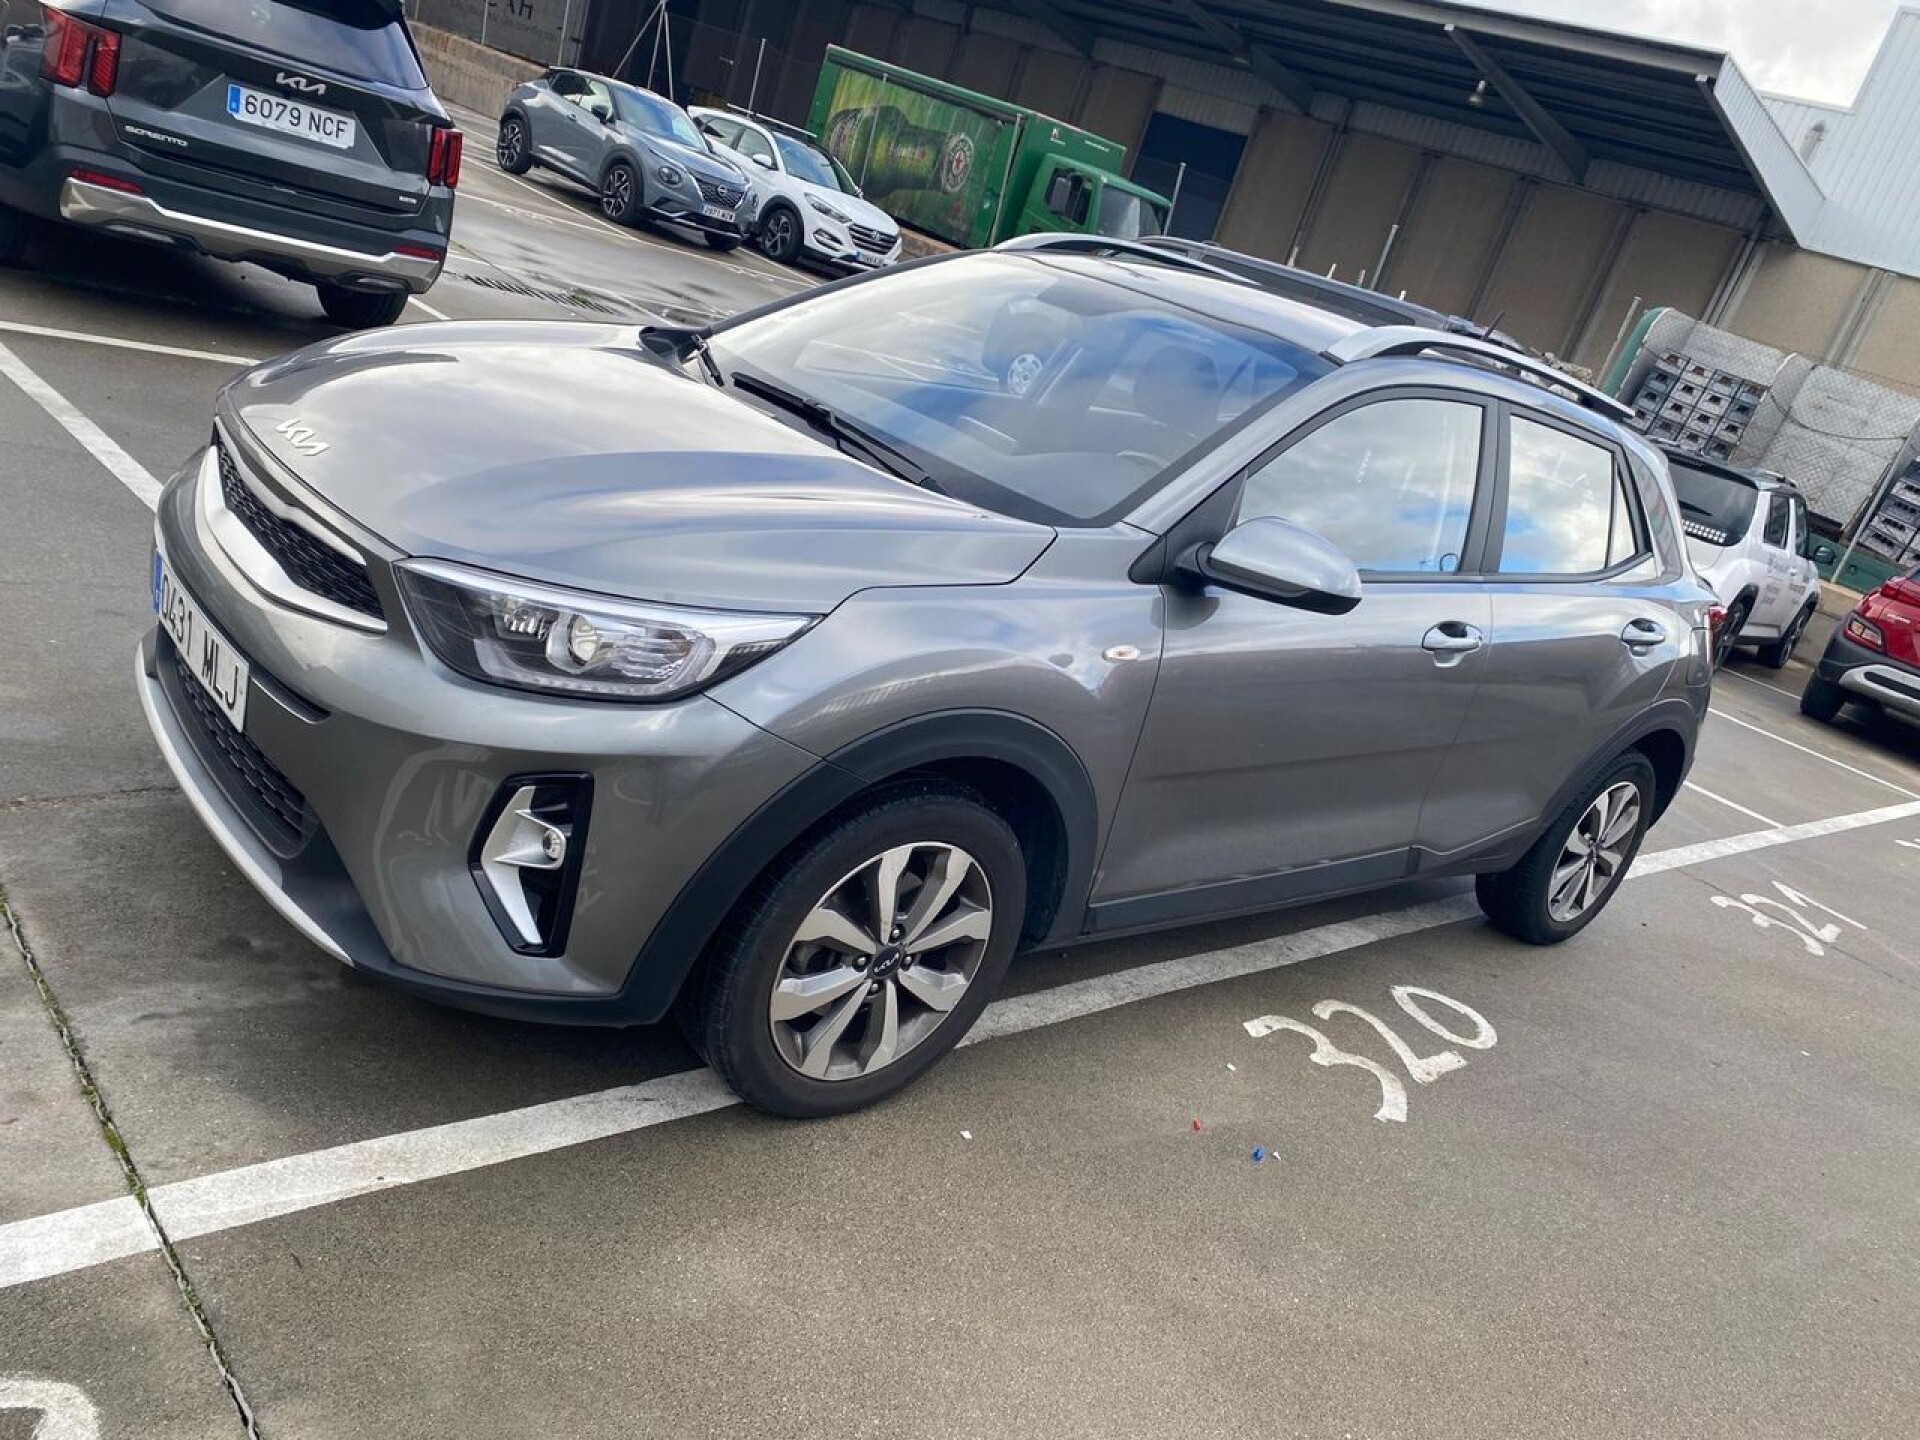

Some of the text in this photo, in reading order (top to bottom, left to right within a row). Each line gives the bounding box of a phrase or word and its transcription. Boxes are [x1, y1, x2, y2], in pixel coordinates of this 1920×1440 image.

[276, 72, 326, 95] KIA
[245, 95, 348, 139] 6079 NCF
[276, 419, 330, 456] KIA
[161, 573, 239, 711] 0431 MLJ
[1243, 985, 1497, 1122] 320
